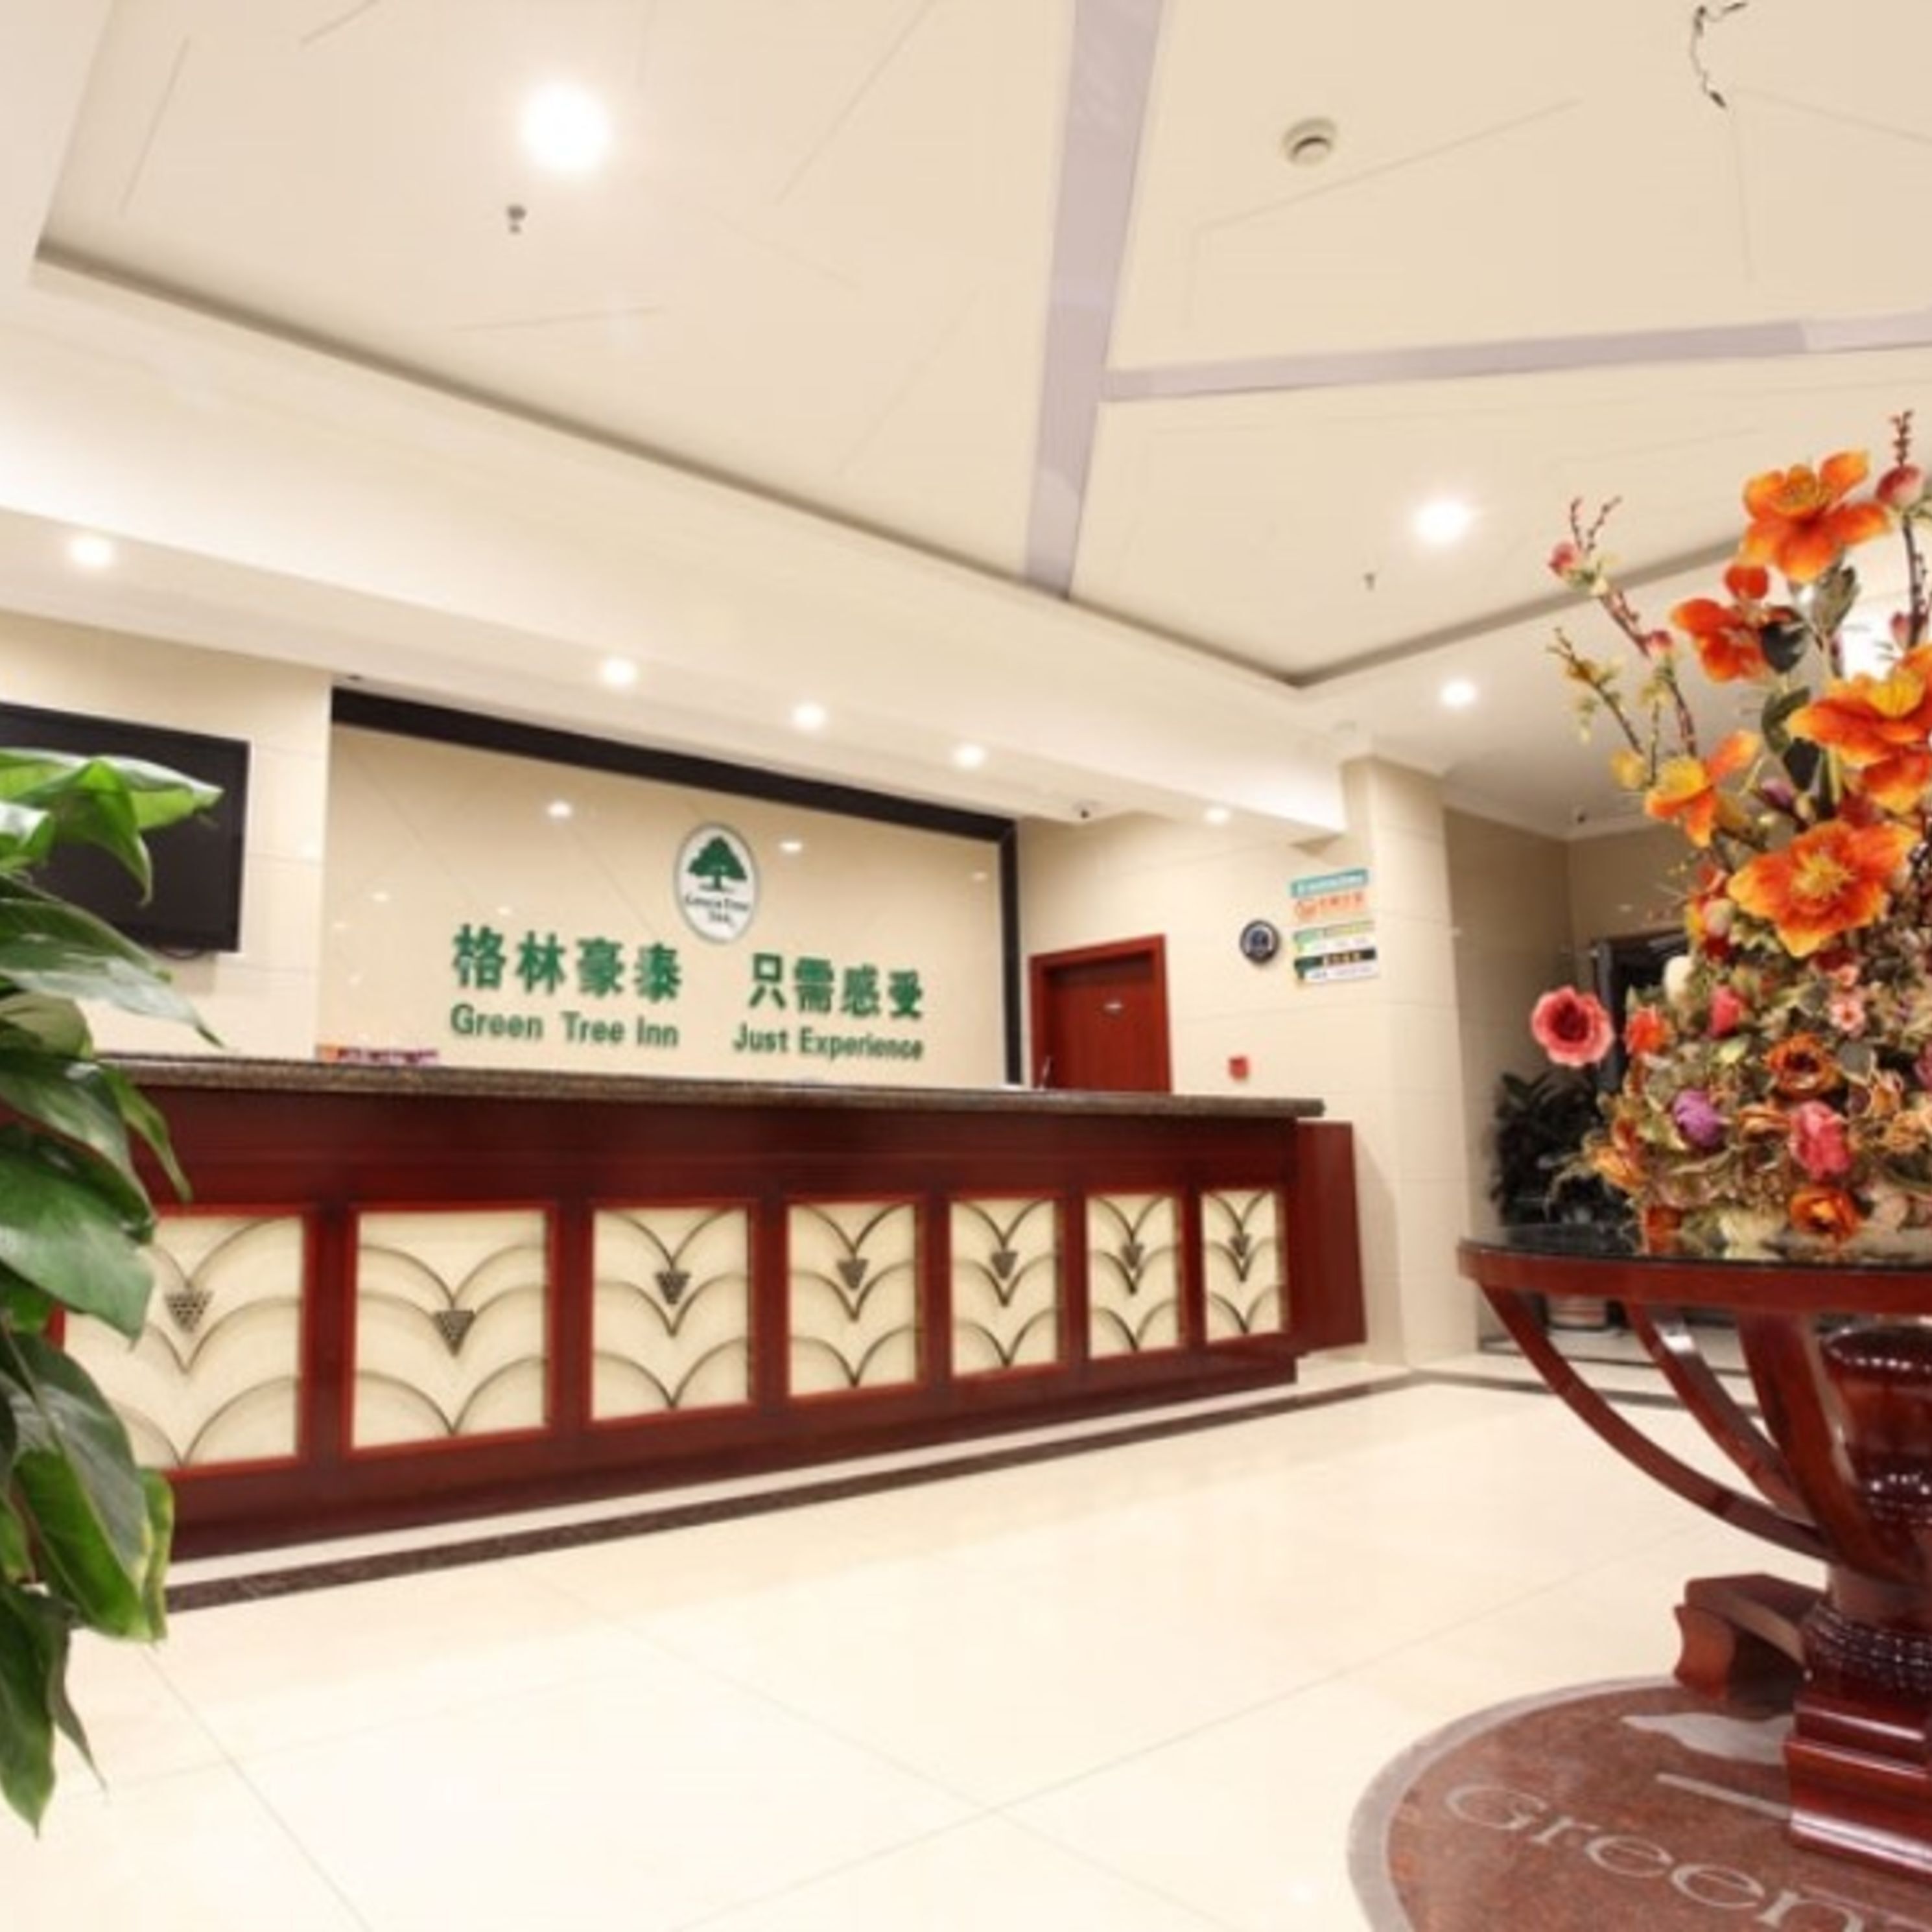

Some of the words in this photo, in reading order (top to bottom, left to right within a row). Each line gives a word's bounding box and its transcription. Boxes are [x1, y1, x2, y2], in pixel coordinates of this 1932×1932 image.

[452, 923, 683, 1002] 格林豪泰
[749, 952, 923, 1019] 只需感受
[451, 1003, 544, 1039] Green
[560, 1010, 626, 1043] Tree
[637, 1015, 679, 1047] Inn
[733, 1022, 788, 1054] Just
[800, 1026, 923, 1061] Experience
[1446, 1784, 1865, 1932] Green
